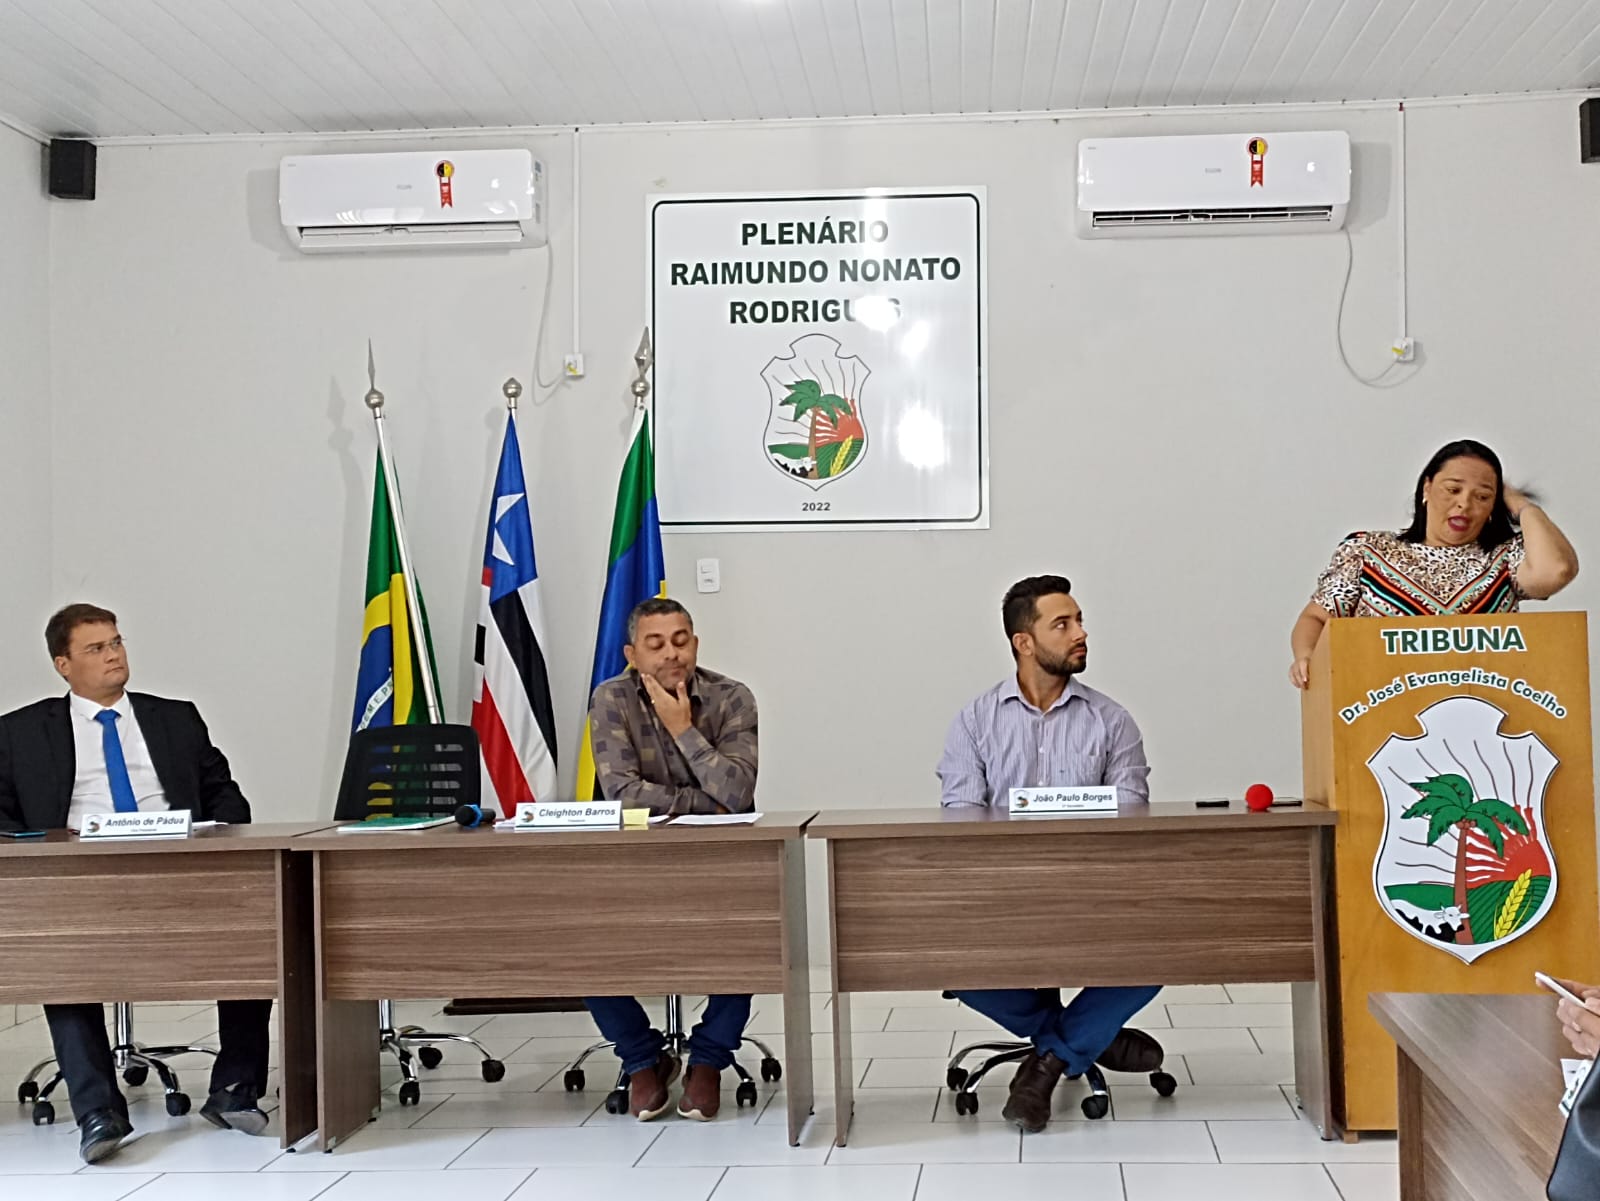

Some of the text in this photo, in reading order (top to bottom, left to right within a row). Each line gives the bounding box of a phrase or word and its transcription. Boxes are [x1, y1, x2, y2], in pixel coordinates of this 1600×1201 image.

[741, 216, 888, 245] PLENÁRIO
[670, 256, 961, 285] RAIMUNDO NONATO
[729, 298, 901, 324] RODRIGU
[801, 501, 831, 512] 2022
[1382, 627, 1525, 653] TRIBUNA
[1340, 668, 1566, 723] Dr. José Evangelista Coelho
[1033, 792, 1113, 803] João Paulo Borges
[105, 816, 185, 827] Antônio de Pádua
[538, 807, 616, 819] Cleighton Barros
